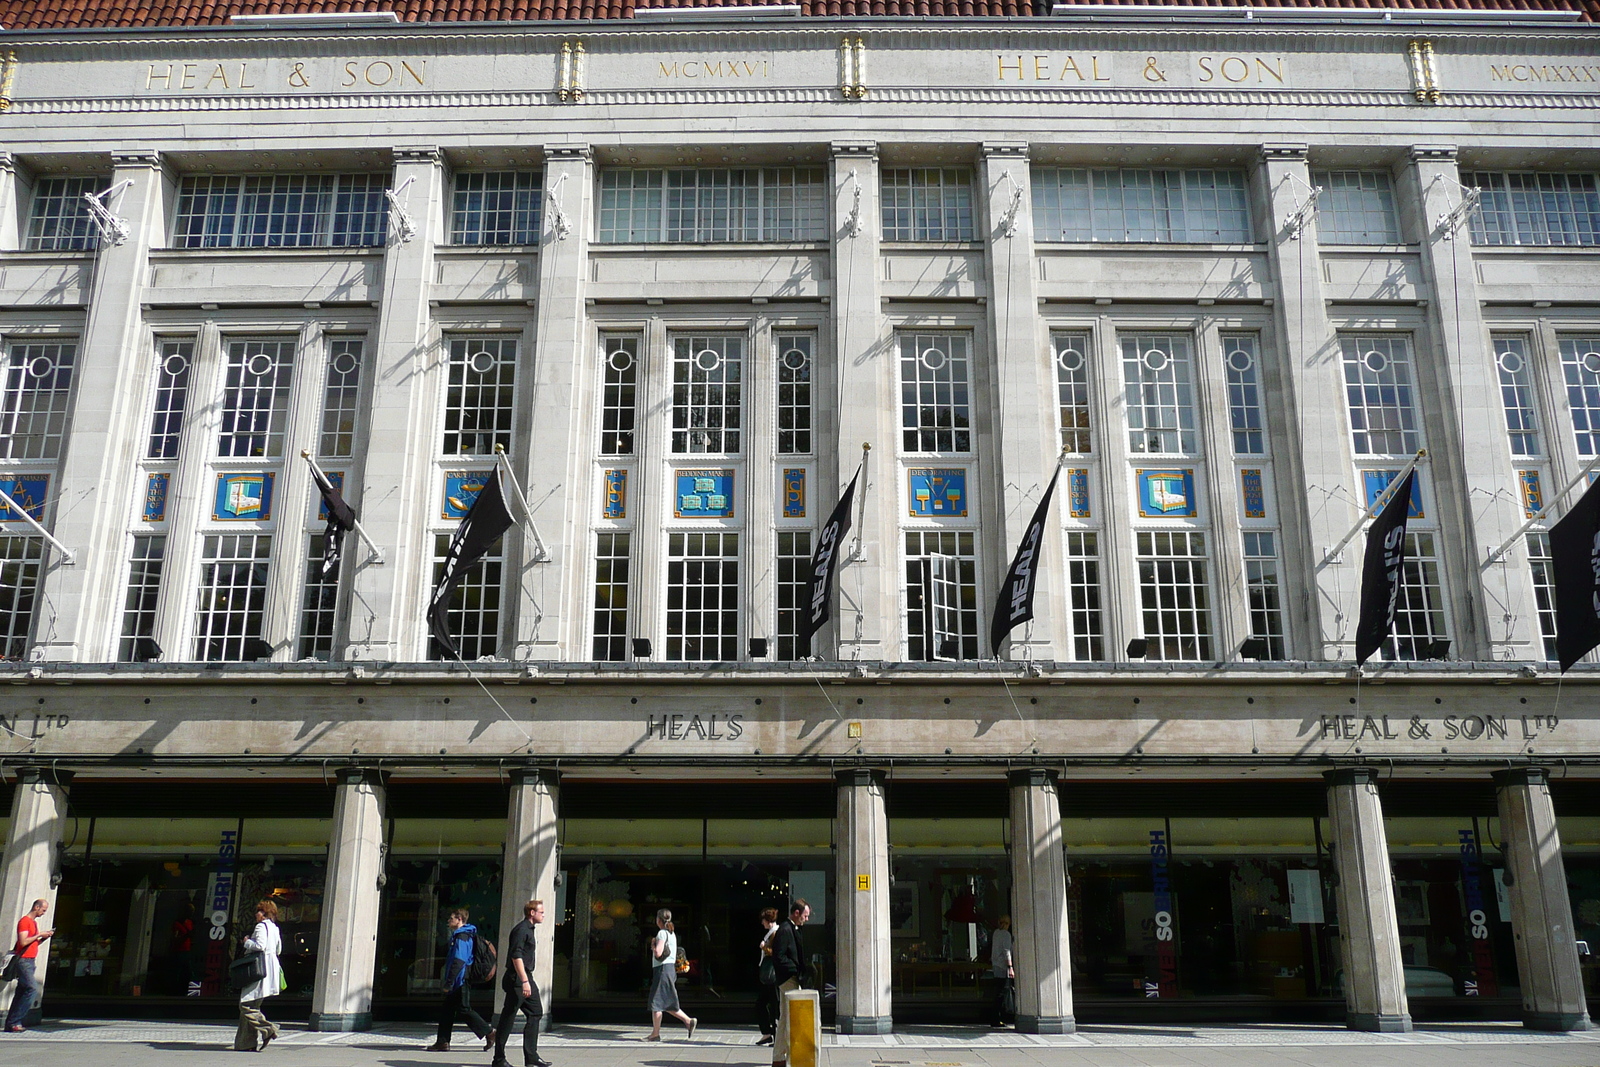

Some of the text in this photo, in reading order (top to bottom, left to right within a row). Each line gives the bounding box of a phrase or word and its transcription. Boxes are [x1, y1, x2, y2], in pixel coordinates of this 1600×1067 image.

[145, 60, 427, 90] HEAL & SON
[658, 60, 768, 78] MCMXVI
[996, 55, 1285, 84] HEAL & SON
[147, 495, 165, 503] SIGN
[149, 488, 163, 496] THE
[811, 520, 839, 624] HEAL'S
[648, 714, 743, 738] HEAL'S
[1321, 714, 1398, 739] HEAL
[1408, 714, 1432, 739] &
[1444, 714, 1508, 740] SON
[858, 876, 869, 889] H
